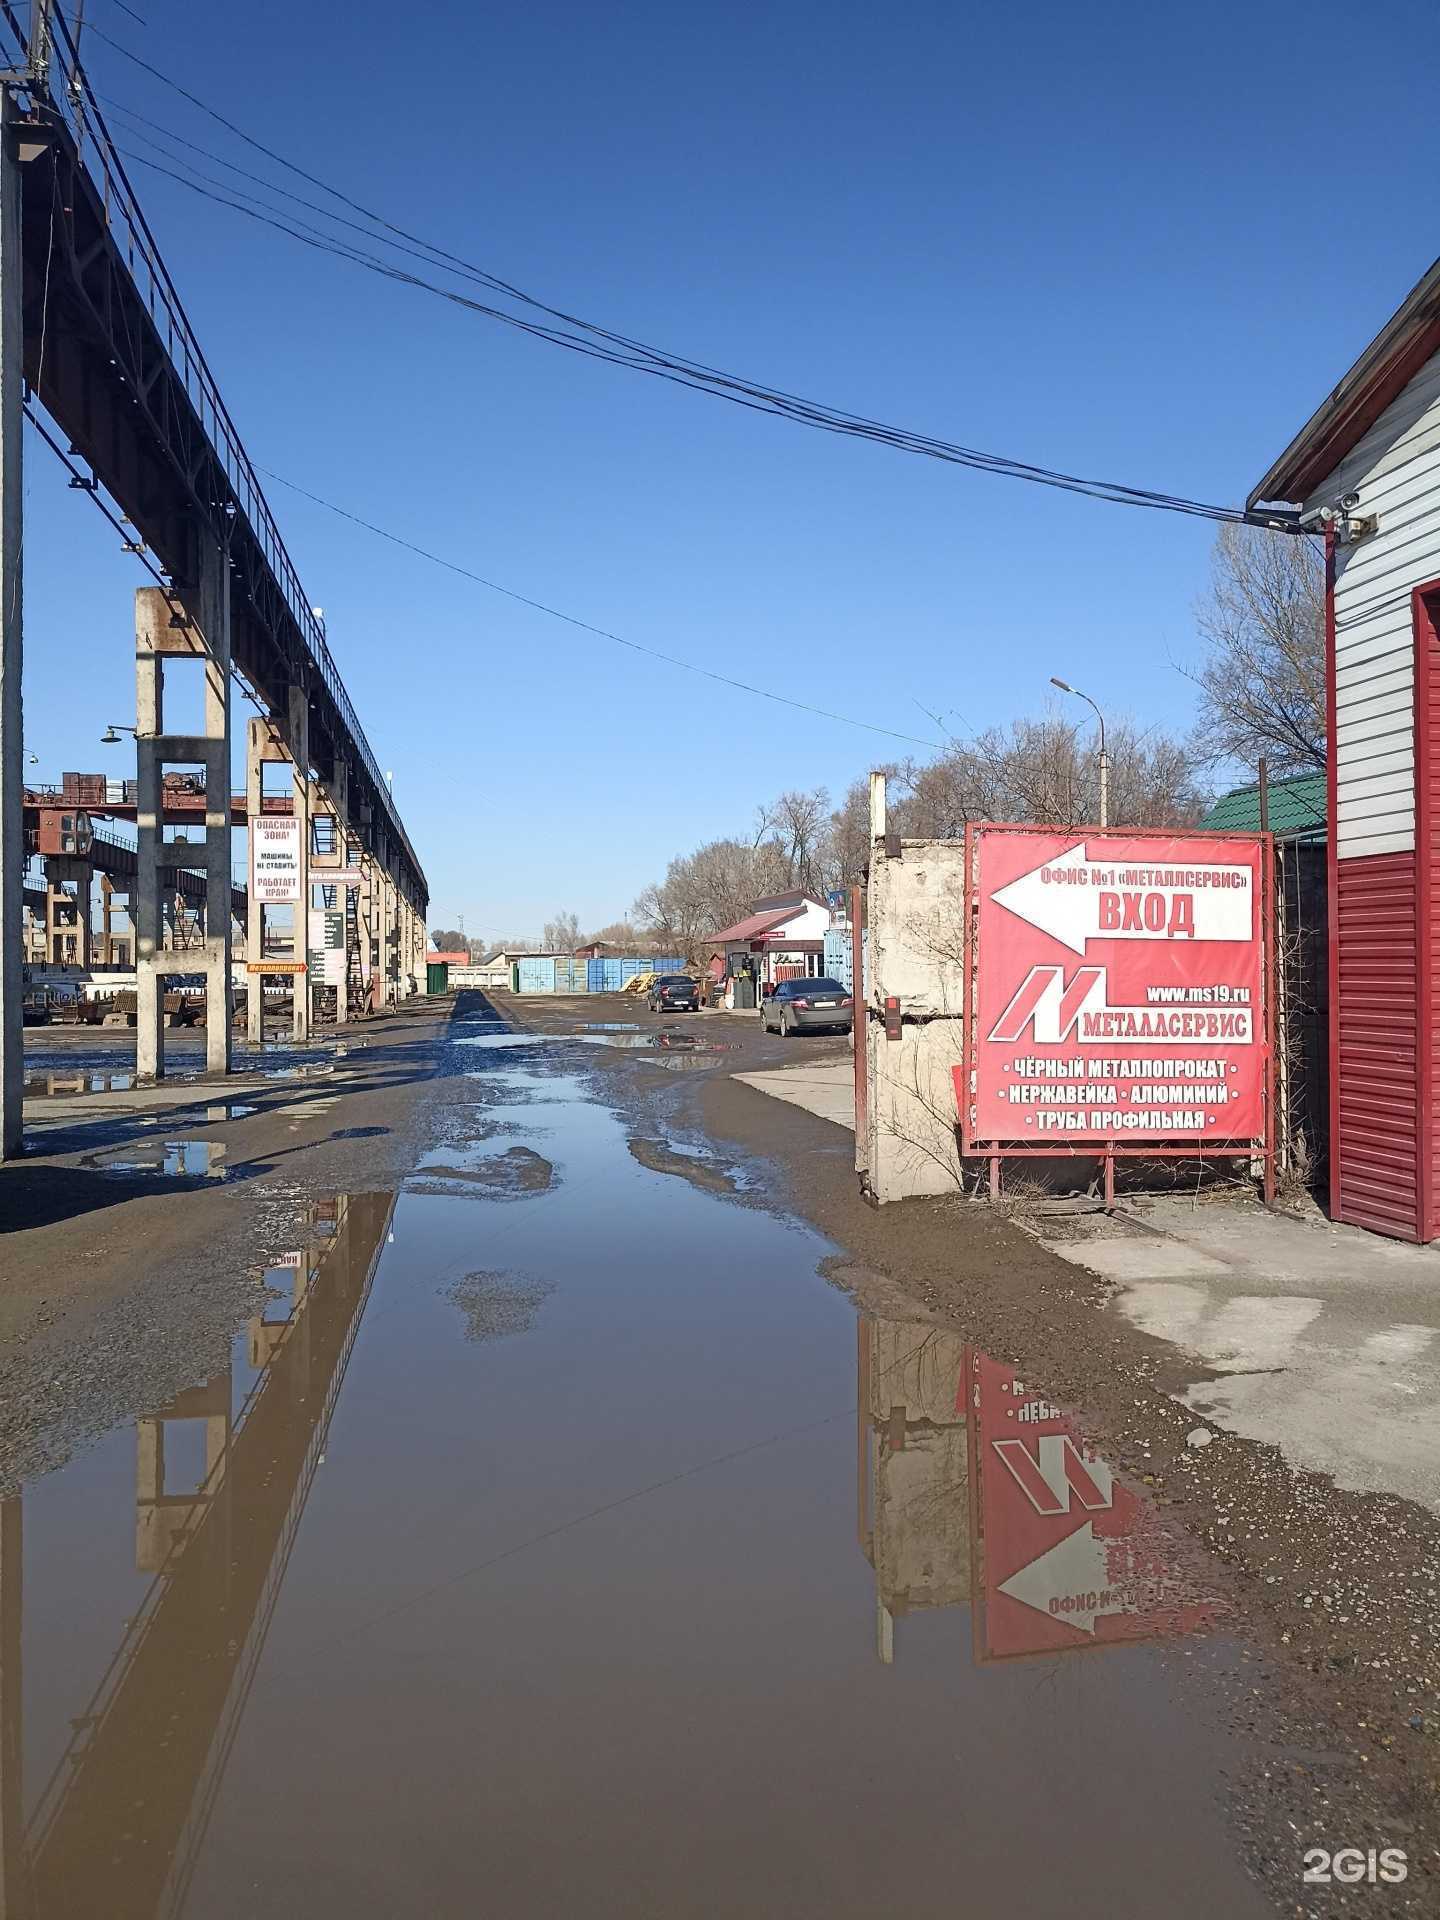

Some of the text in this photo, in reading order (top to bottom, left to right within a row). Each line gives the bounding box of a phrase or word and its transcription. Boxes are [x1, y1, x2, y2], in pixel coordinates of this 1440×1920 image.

[257, 820, 297, 830] ОПАСНАЯ
[264, 831, 290, 840] ЗОНА!
[257, 862, 264, 870] НЕ
[257, 877, 297, 887] РАБОТАЕТ
[1040, 867, 1248, 889] ОФИС №1 «МЕТАЛЛСЕРВИС»
[265, 888, 289, 897] КРАН!
[1098, 892, 1195, 938] ВХОД
[1146, 984, 1250, 1003] www.ms19.ru
[1082, 1012, 1248, 1038] МЕТАЛЛСЕРВИС
[1013, 1056, 1227, 1079] ЧЁРНЫЙ МЕТАЛЛОПРОКАТ
[1008, 1082, 1228, 1104] НЕРЖАВЕЙКА АЛЮМИНИЙ
[1036, 1110, 1205, 1130] ТРУБА ПРОФИЛЬНАЯ
